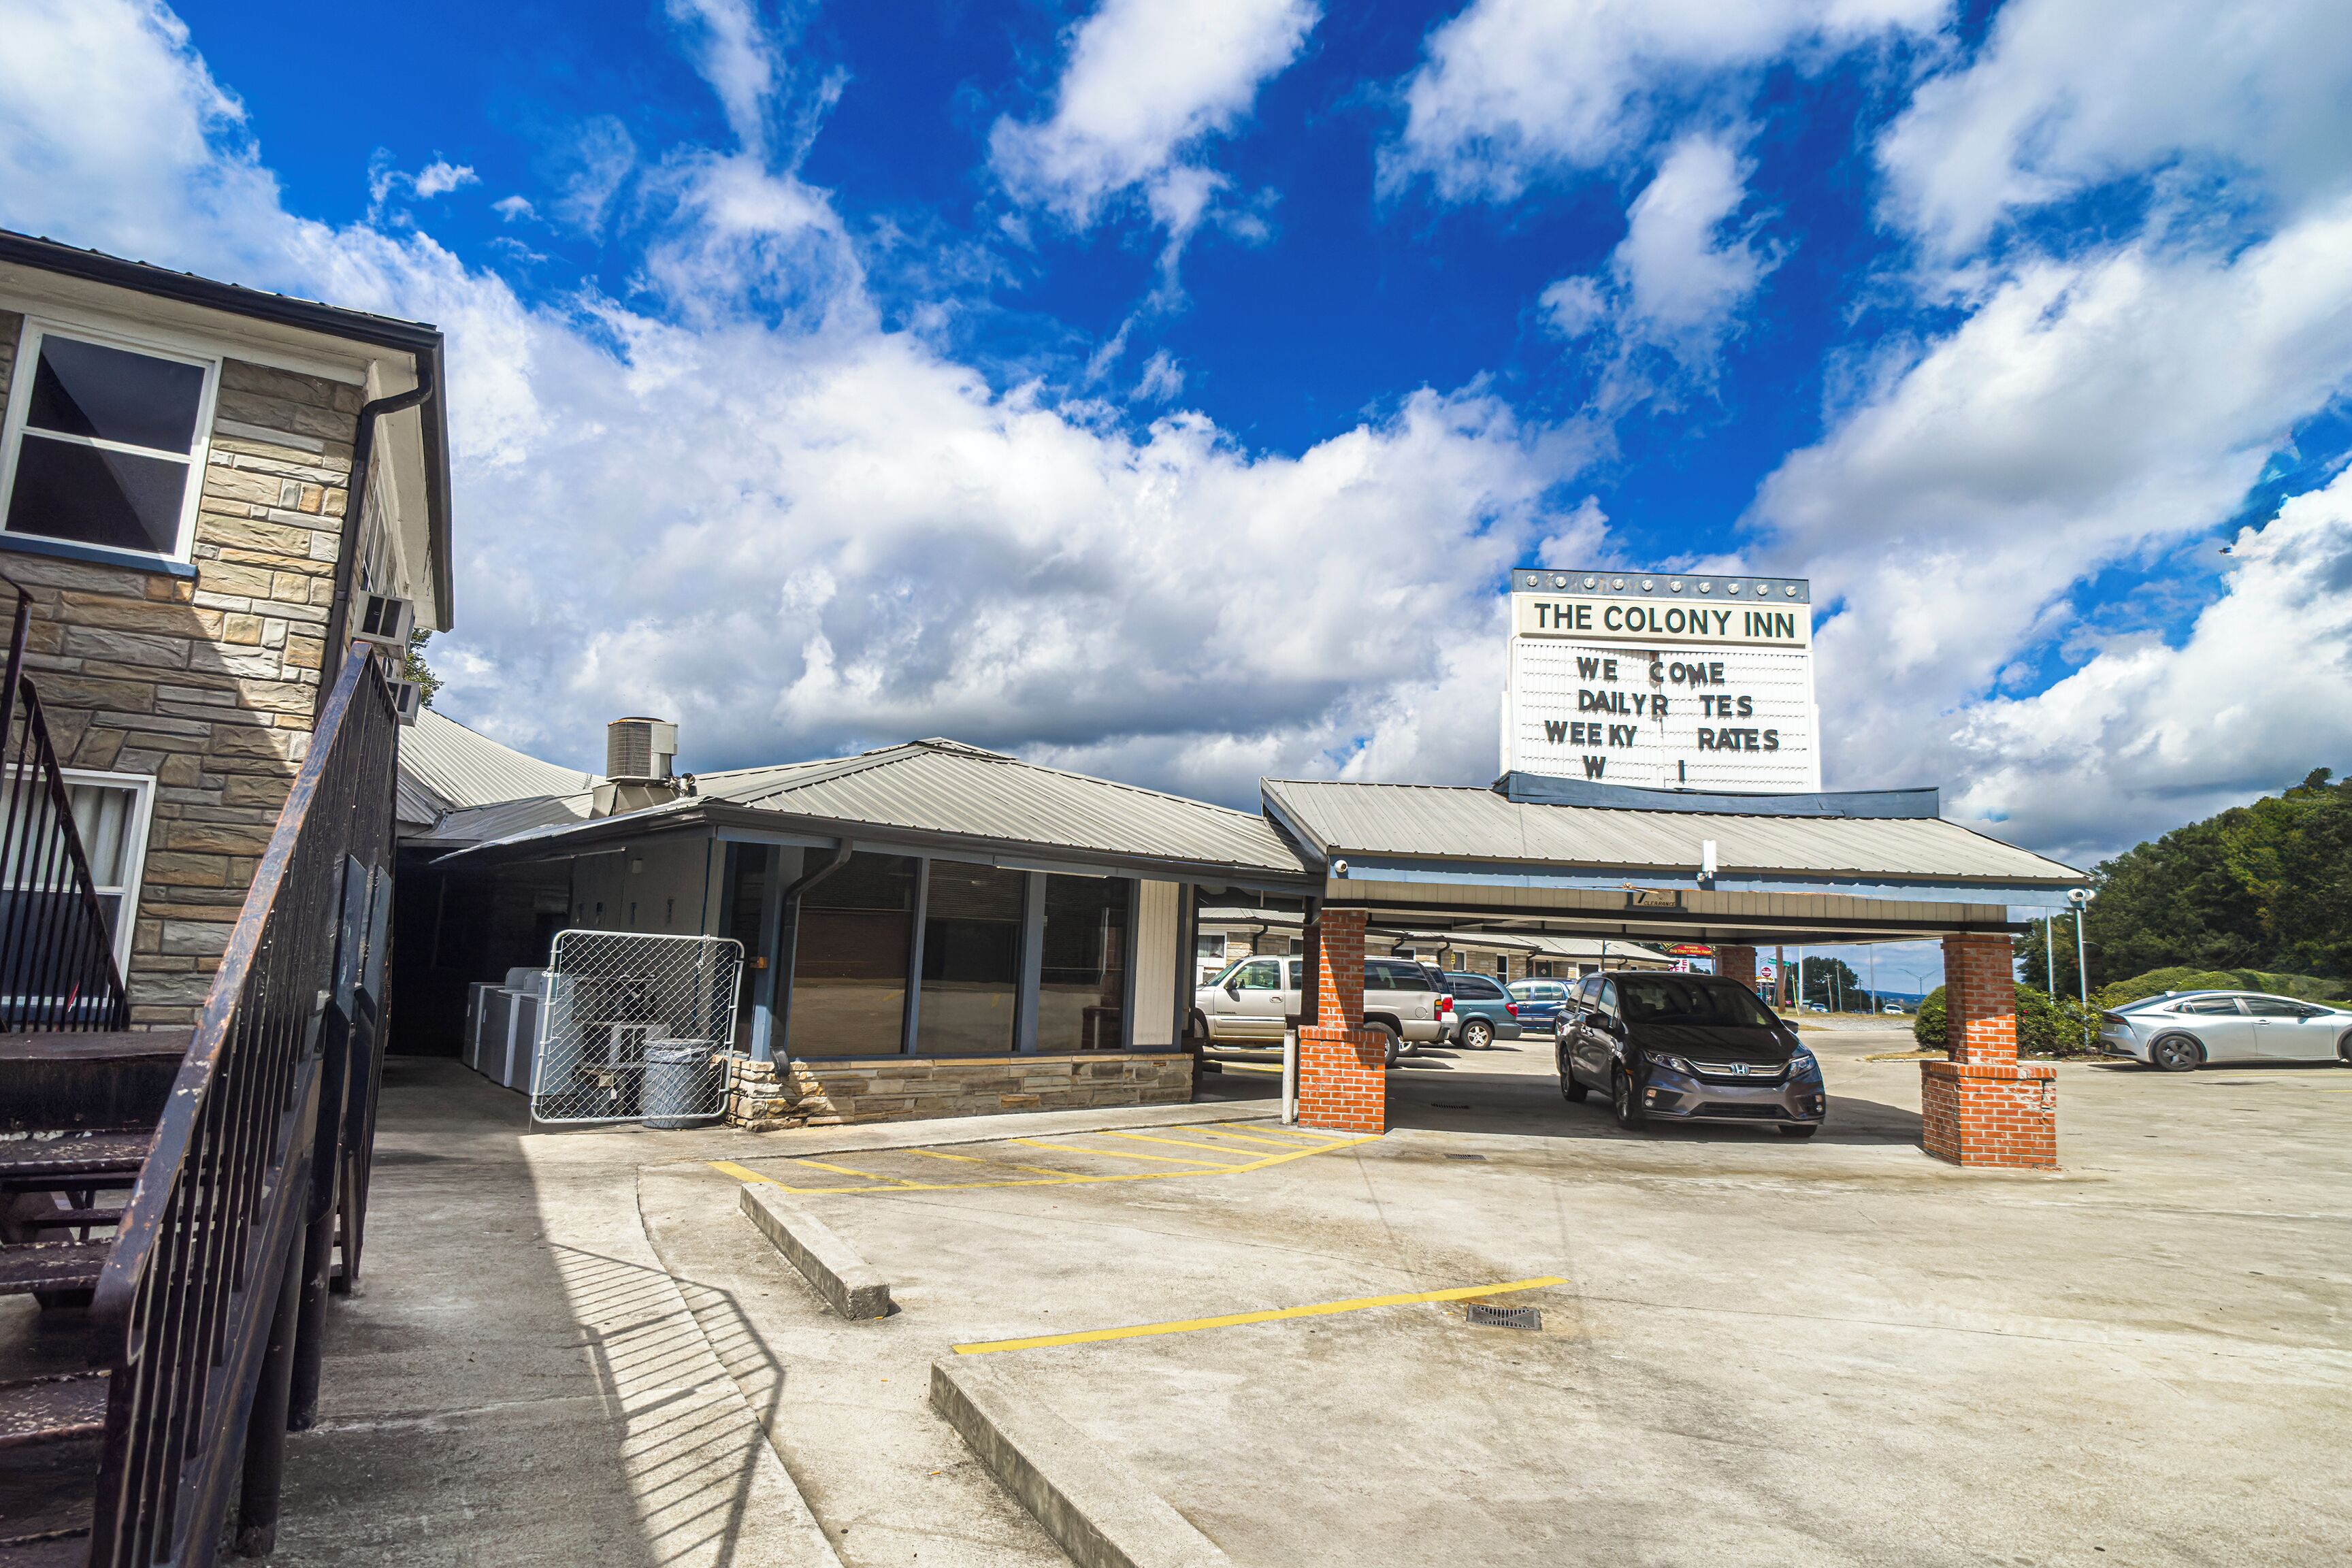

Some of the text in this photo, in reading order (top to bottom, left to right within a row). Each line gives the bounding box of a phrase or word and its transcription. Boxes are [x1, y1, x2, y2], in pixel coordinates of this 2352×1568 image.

[1534, 603, 1795, 638] THE COLONY INN
[1698, 728, 1780, 751] RATES
[1582, 755, 1606, 779] W
